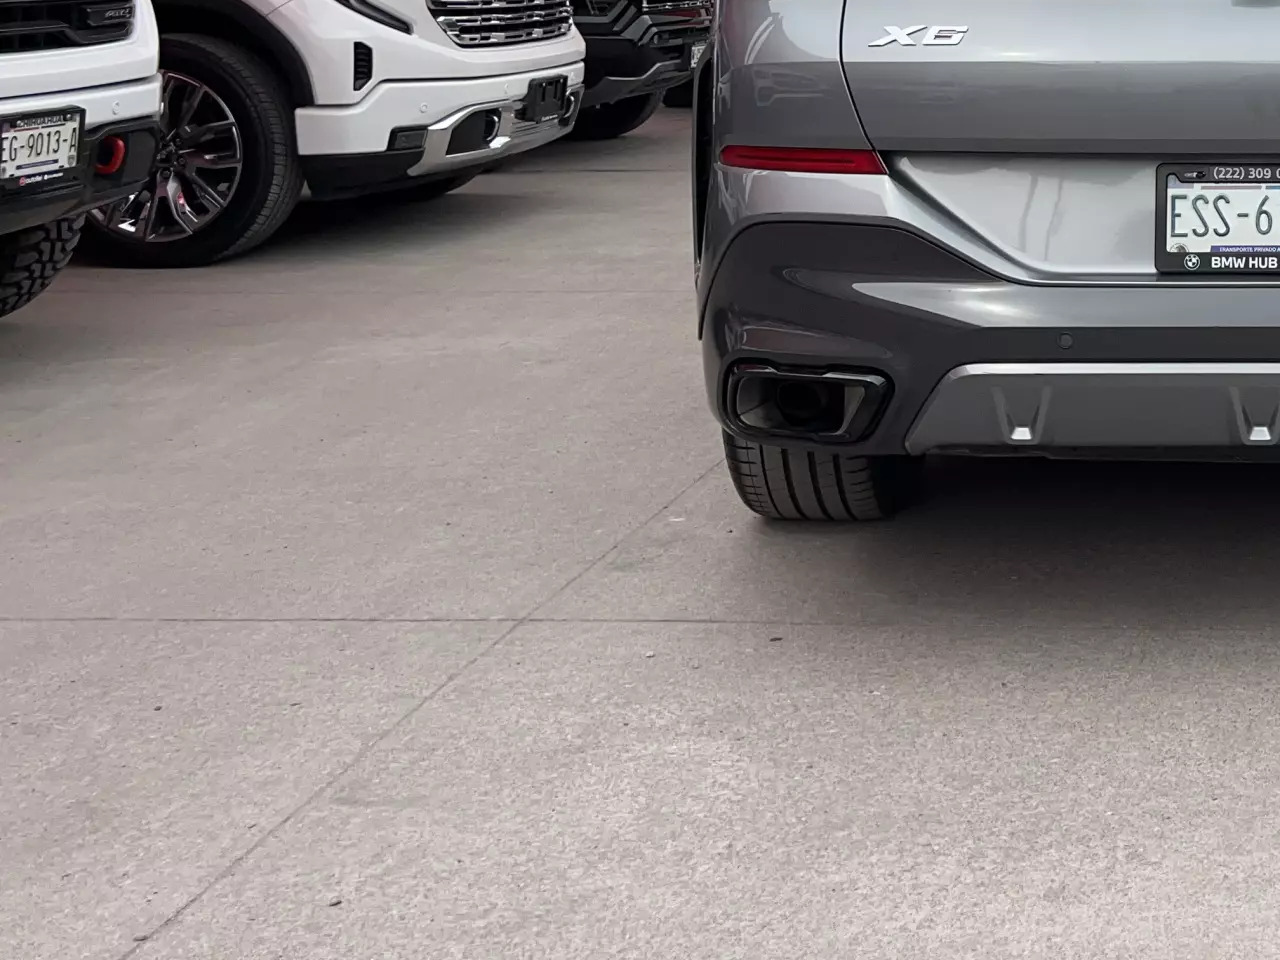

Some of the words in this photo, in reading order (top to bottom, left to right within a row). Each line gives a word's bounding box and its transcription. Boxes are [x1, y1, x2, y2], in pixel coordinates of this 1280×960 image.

[868, 25, 969, 47] X6
[1213, 167, 1245, 180] (222)
[1248, 168, 1271, 179] 309
[1211, 256, 1246, 269] BMW
[1248, 256, 1278, 269] HUB
